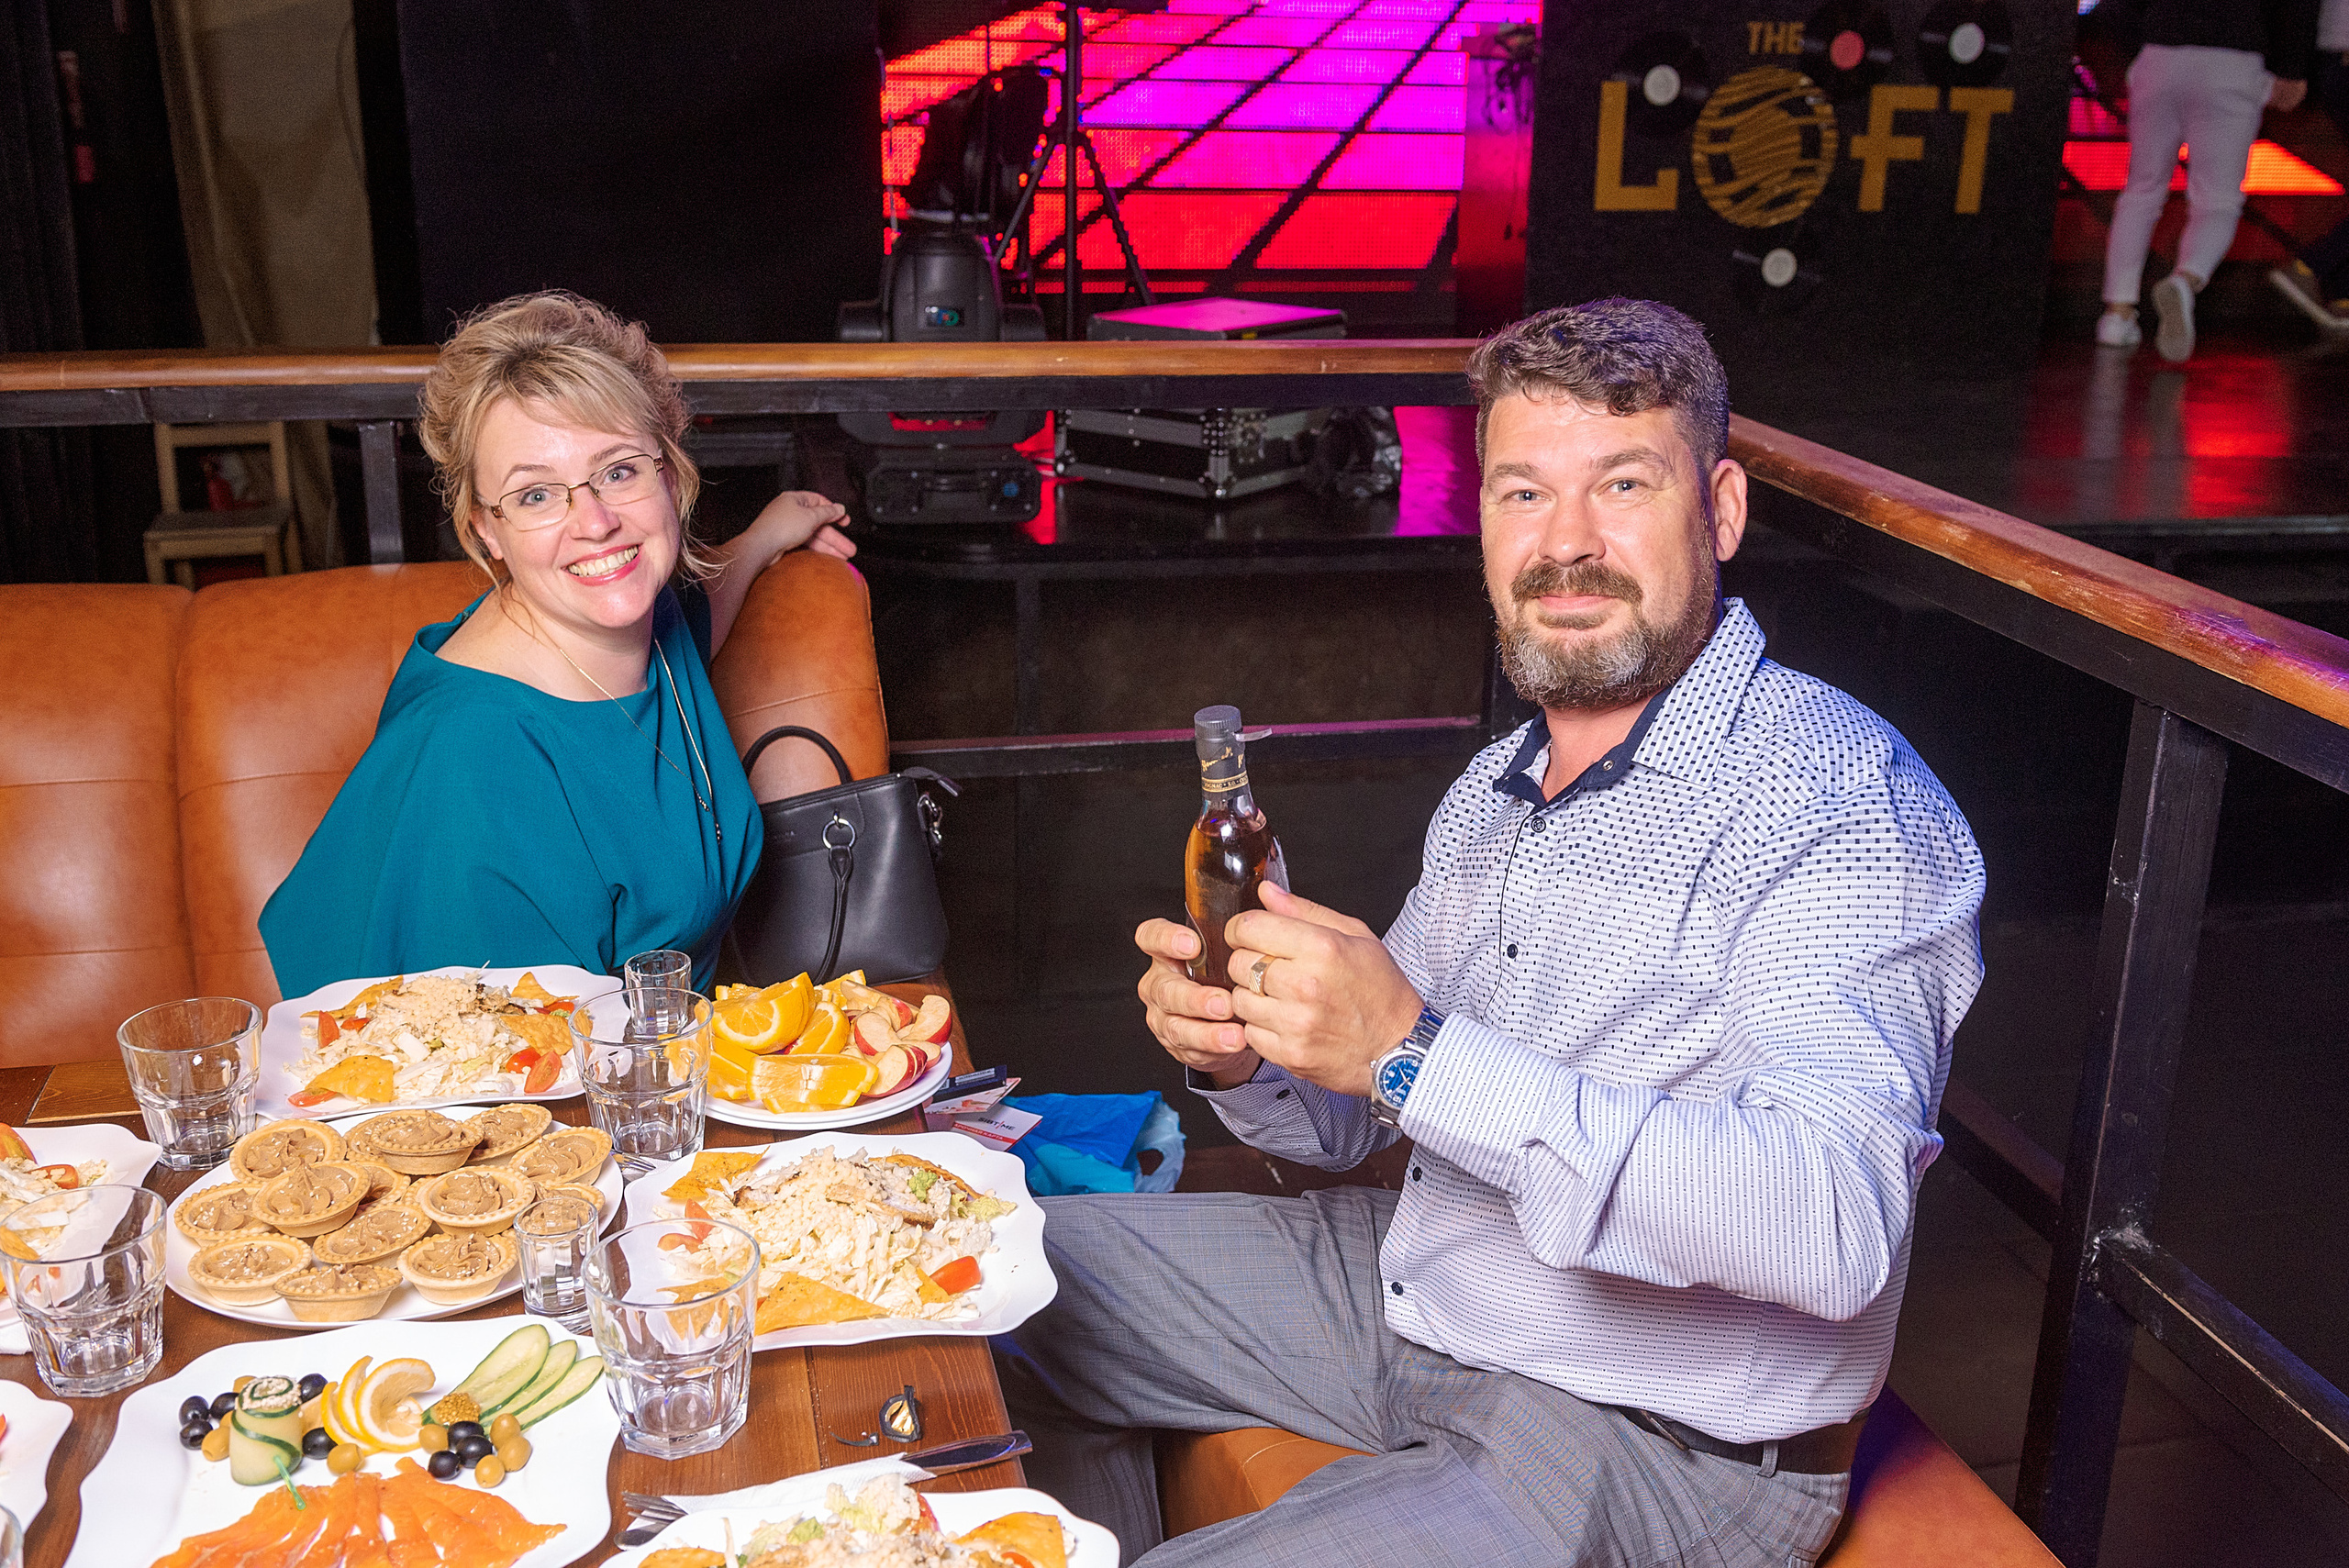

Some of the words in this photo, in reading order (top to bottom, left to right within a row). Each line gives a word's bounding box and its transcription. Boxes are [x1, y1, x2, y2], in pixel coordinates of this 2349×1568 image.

[1747, 21, 1806, 55] THE
[1594, 66, 2015, 228] LOFT
[983, 1132, 1003, 1140] КАРТА
